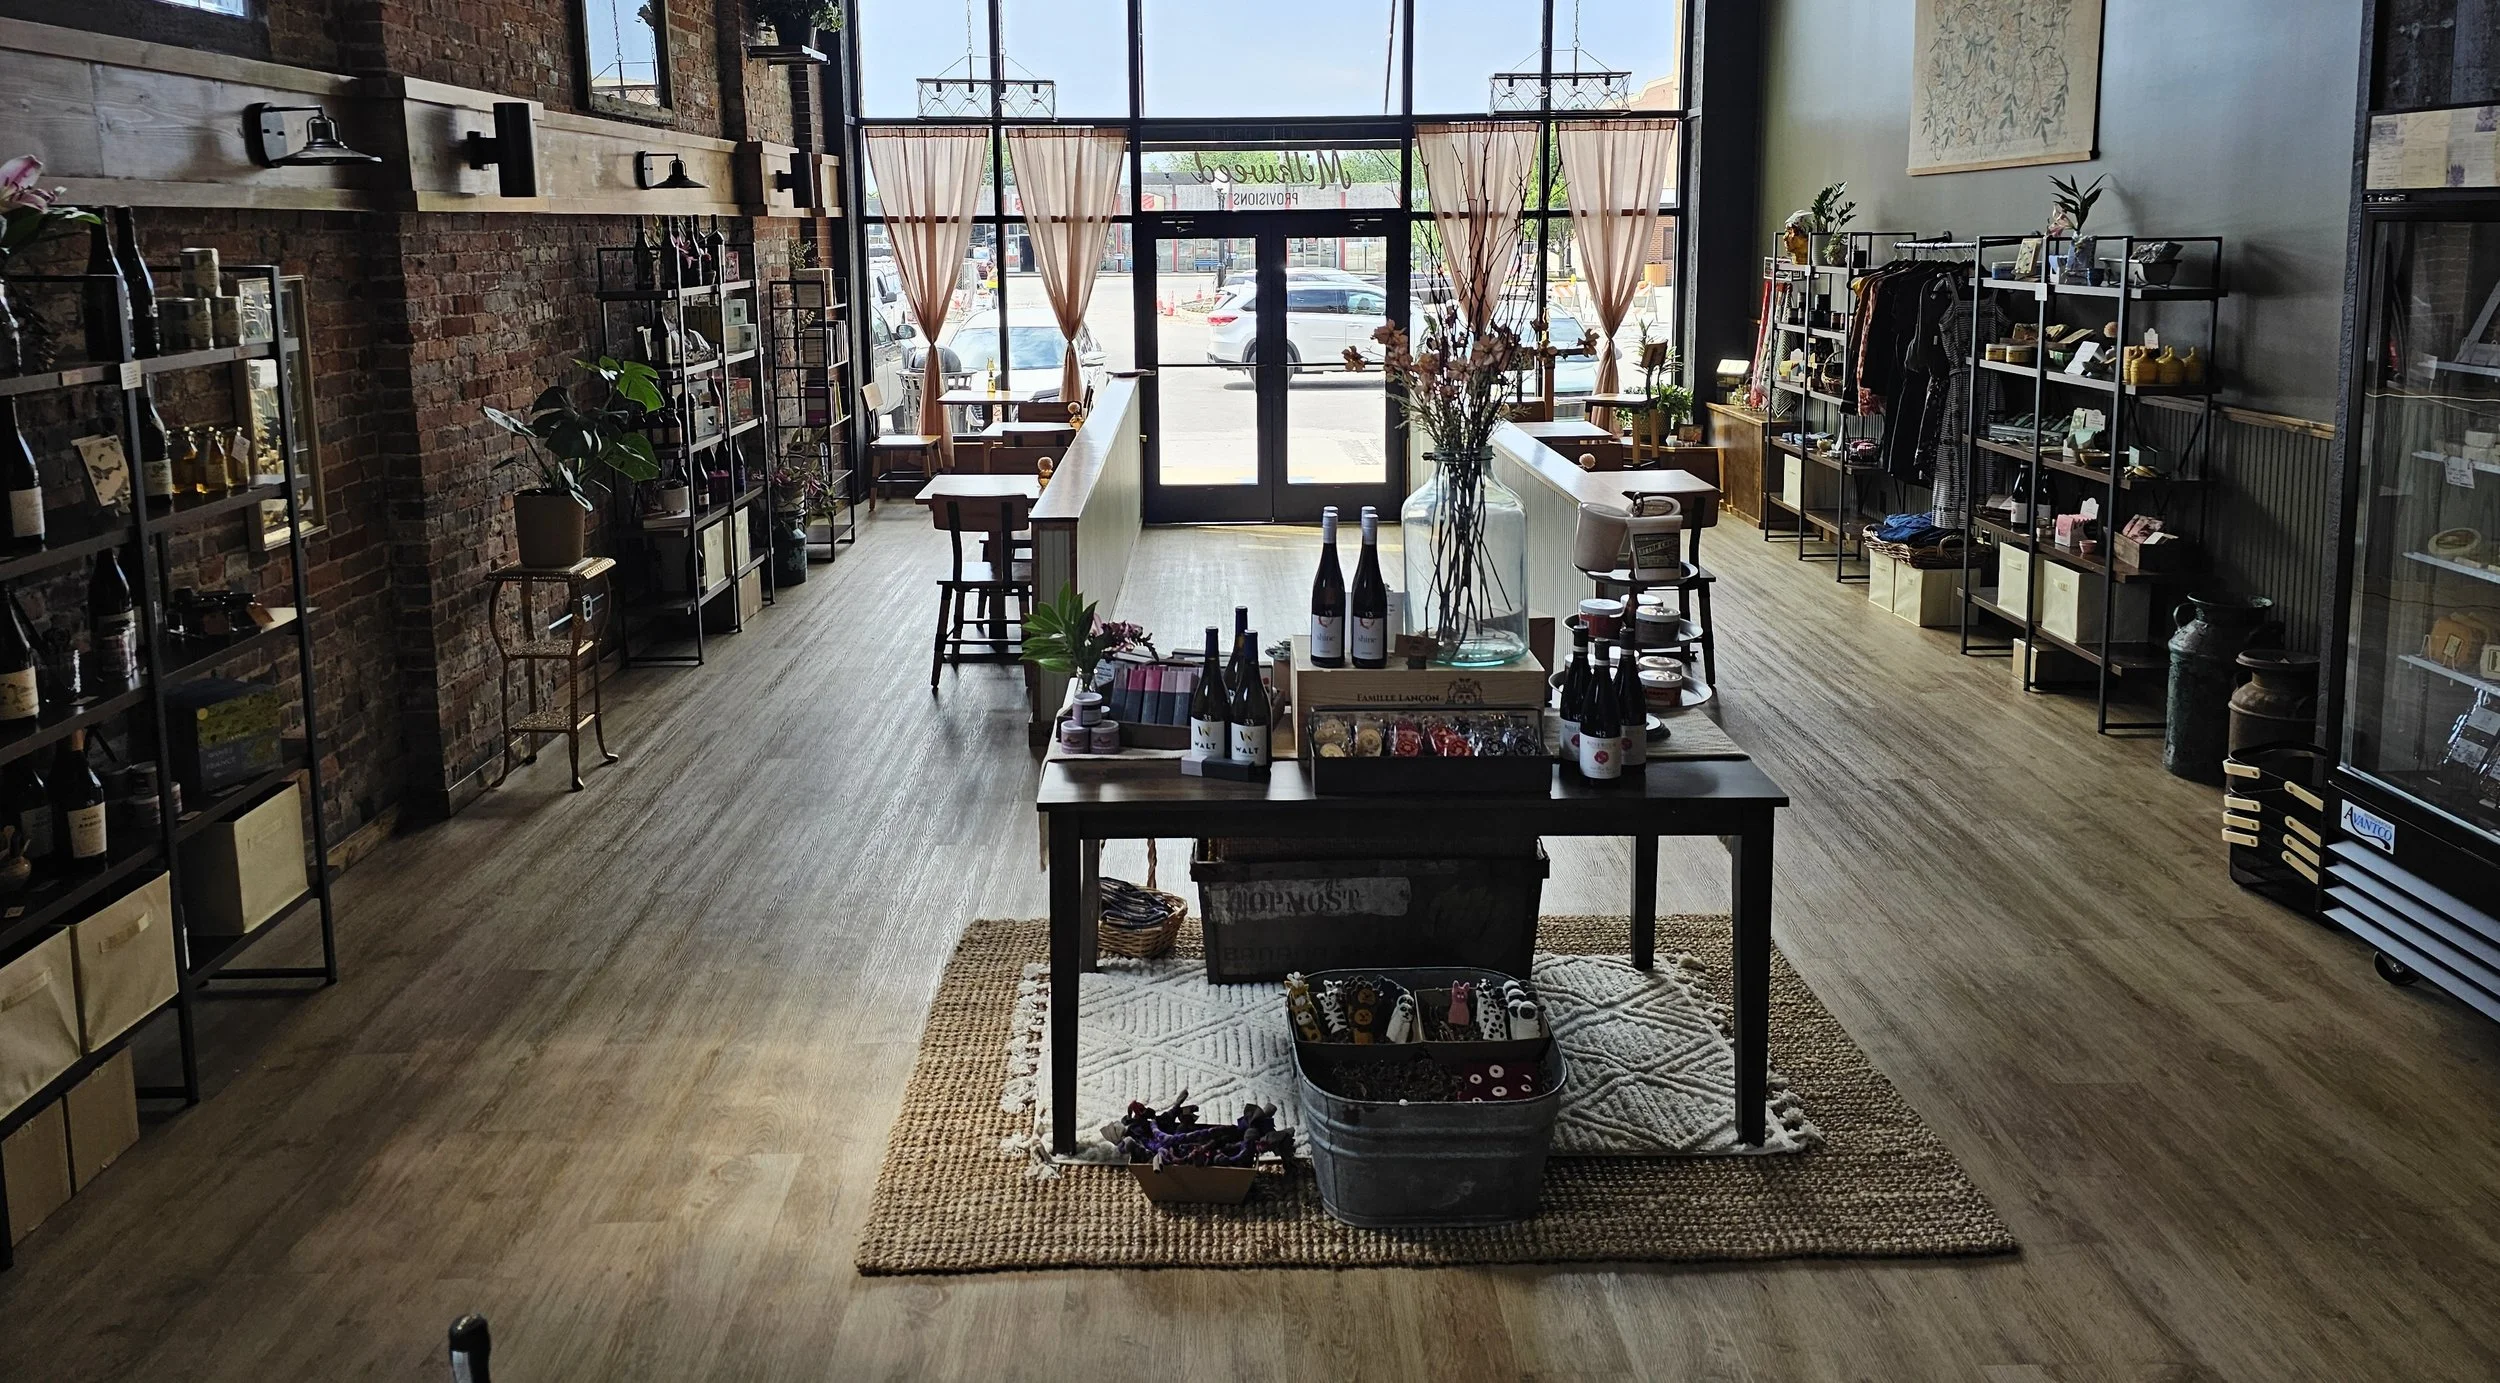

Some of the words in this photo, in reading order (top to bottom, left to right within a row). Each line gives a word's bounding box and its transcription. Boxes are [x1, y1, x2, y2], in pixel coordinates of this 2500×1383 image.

[1356, 693, 1395, 702] FAMILLE
[1399, 693, 1440, 704] LANÇON
[1194, 741, 1217, 750] WALT
[1235, 745, 1260, 755] WALT
[2343, 806, 2393, 845] AVANTCO
[1231, 885, 1361, 914] TOPMOST
